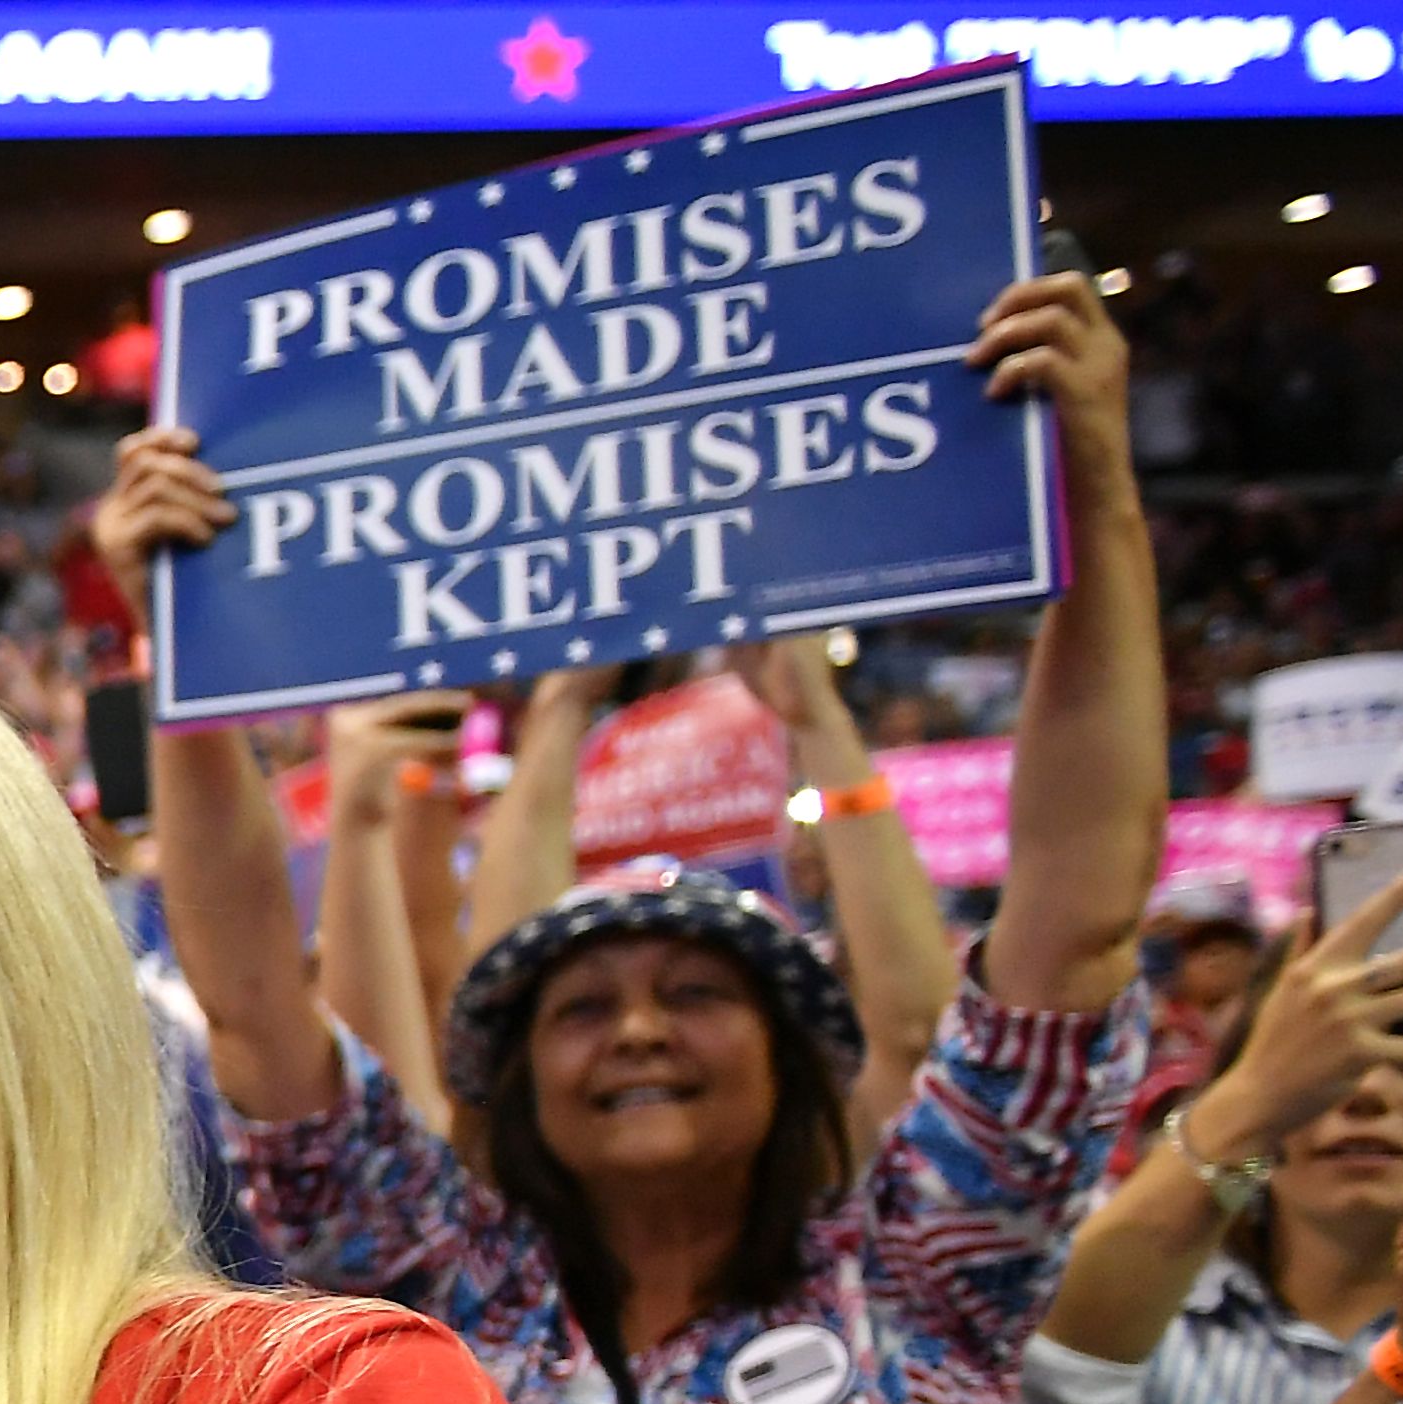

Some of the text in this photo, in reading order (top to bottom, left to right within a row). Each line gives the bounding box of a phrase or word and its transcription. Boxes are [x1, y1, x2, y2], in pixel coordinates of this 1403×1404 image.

[766, 19, 936, 91] Text
[1303, 17, 1393, 82] to
[241, 155, 926, 375] PROMISES
[374, 281, 776, 435] MADE
[244, 380, 938, 580] PROMISES
[390, 506, 754, 650] KEPT
